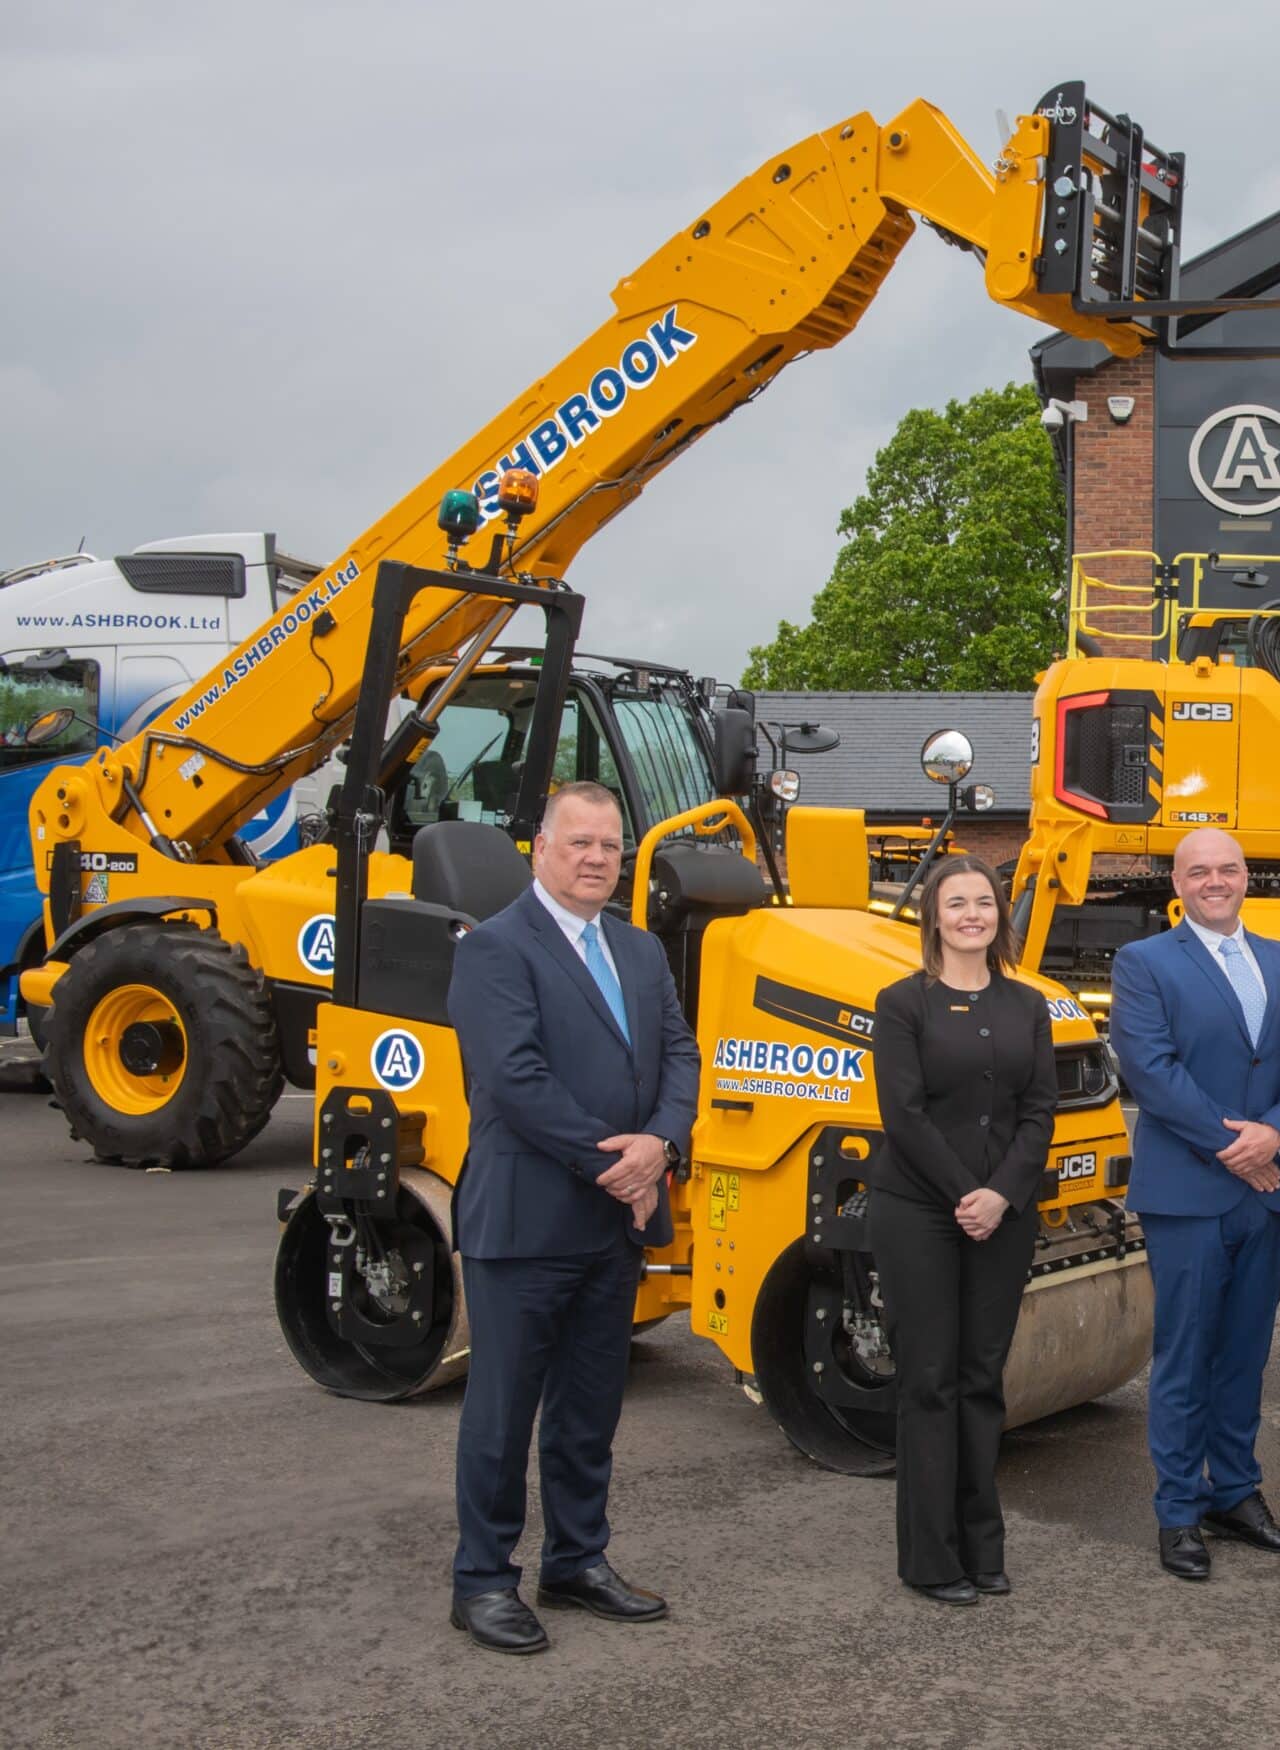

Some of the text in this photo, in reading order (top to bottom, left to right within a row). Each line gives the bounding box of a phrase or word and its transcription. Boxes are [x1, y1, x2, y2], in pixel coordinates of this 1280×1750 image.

[464, 304, 698, 534] SHBROOK
[16, 613, 221, 631] www.ASHBROOK.Ltd
[173, 560, 361, 732] www.ASHBROOK.Ltd
[1173, 703, 1233, 721] JCB
[80, 853, 135, 871] 40-200
[714, 1038, 866, 1081] ASHBROOK
[716, 1078, 851, 1102] www.ASHBROOK.Ltd
[1058, 1153, 1096, 1180] JCB
